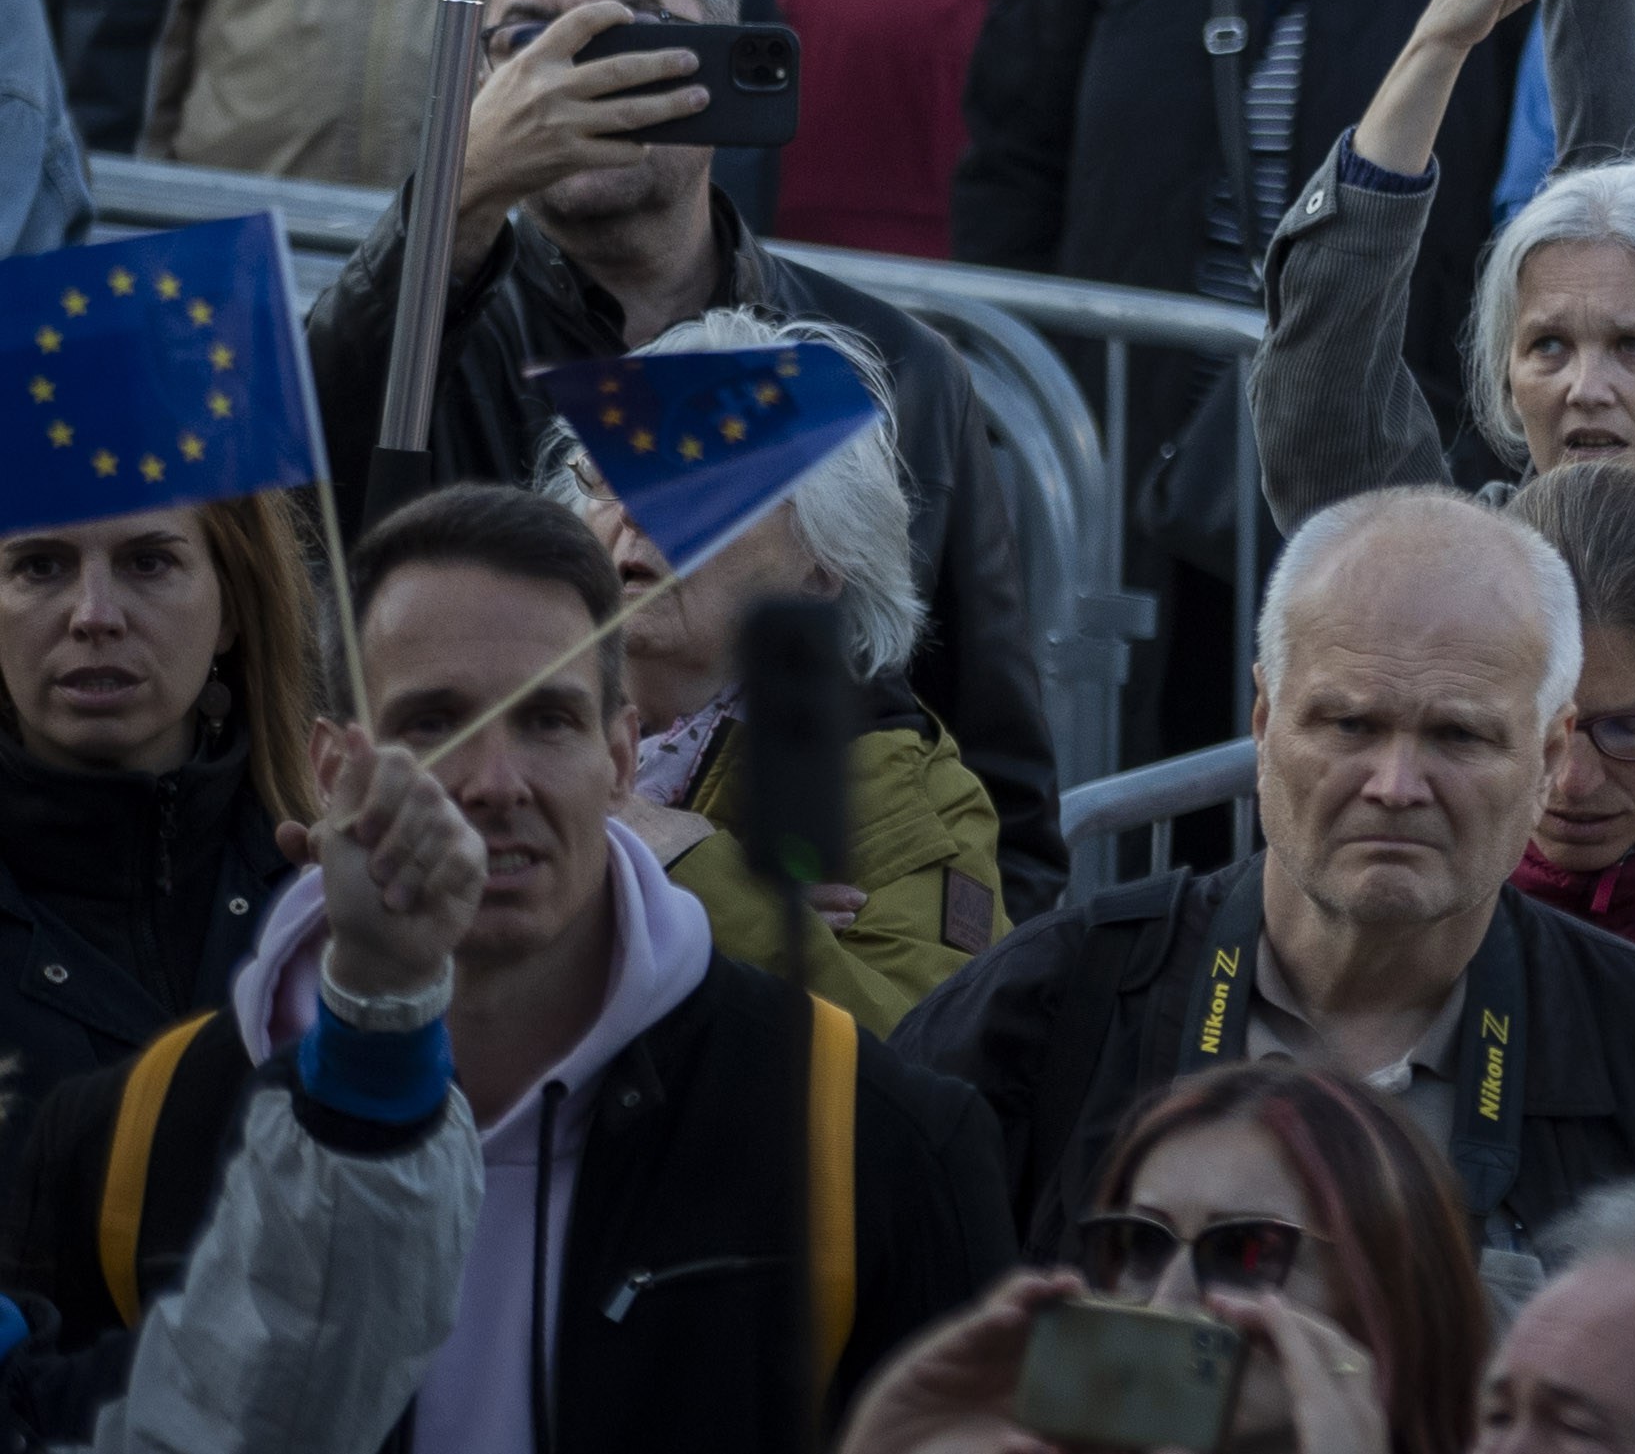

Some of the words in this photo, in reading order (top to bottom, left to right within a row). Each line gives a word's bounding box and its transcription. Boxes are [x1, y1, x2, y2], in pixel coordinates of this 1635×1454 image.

[1212, 947, 1240, 977] Z
[1200, 983, 1230, 1054] Nikon
[1482, 1008, 1509, 1044] Z
[1477, 1046, 1504, 1121] Nikon
